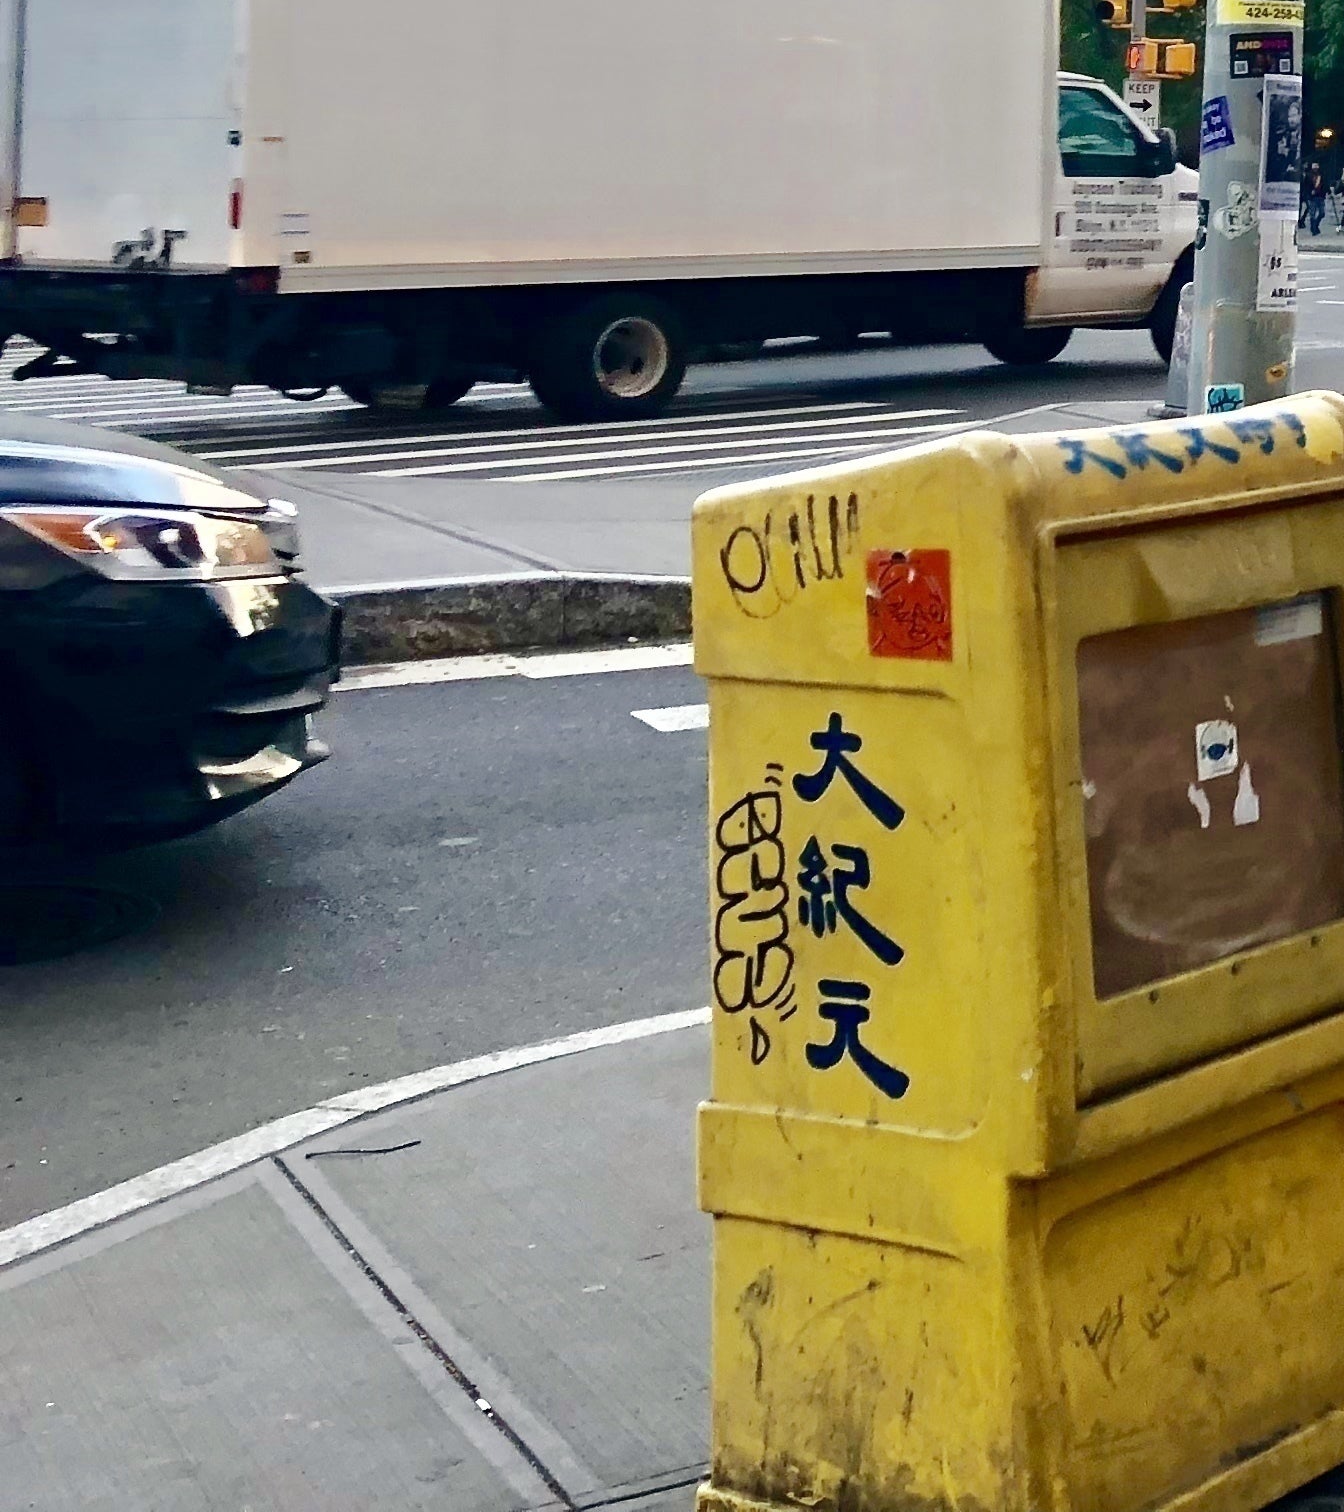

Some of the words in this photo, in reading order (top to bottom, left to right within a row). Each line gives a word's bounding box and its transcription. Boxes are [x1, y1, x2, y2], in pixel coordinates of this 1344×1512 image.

[1129, 84, 1155, 94] KEEP
[792, 711, 910, 1099] 大紀元
